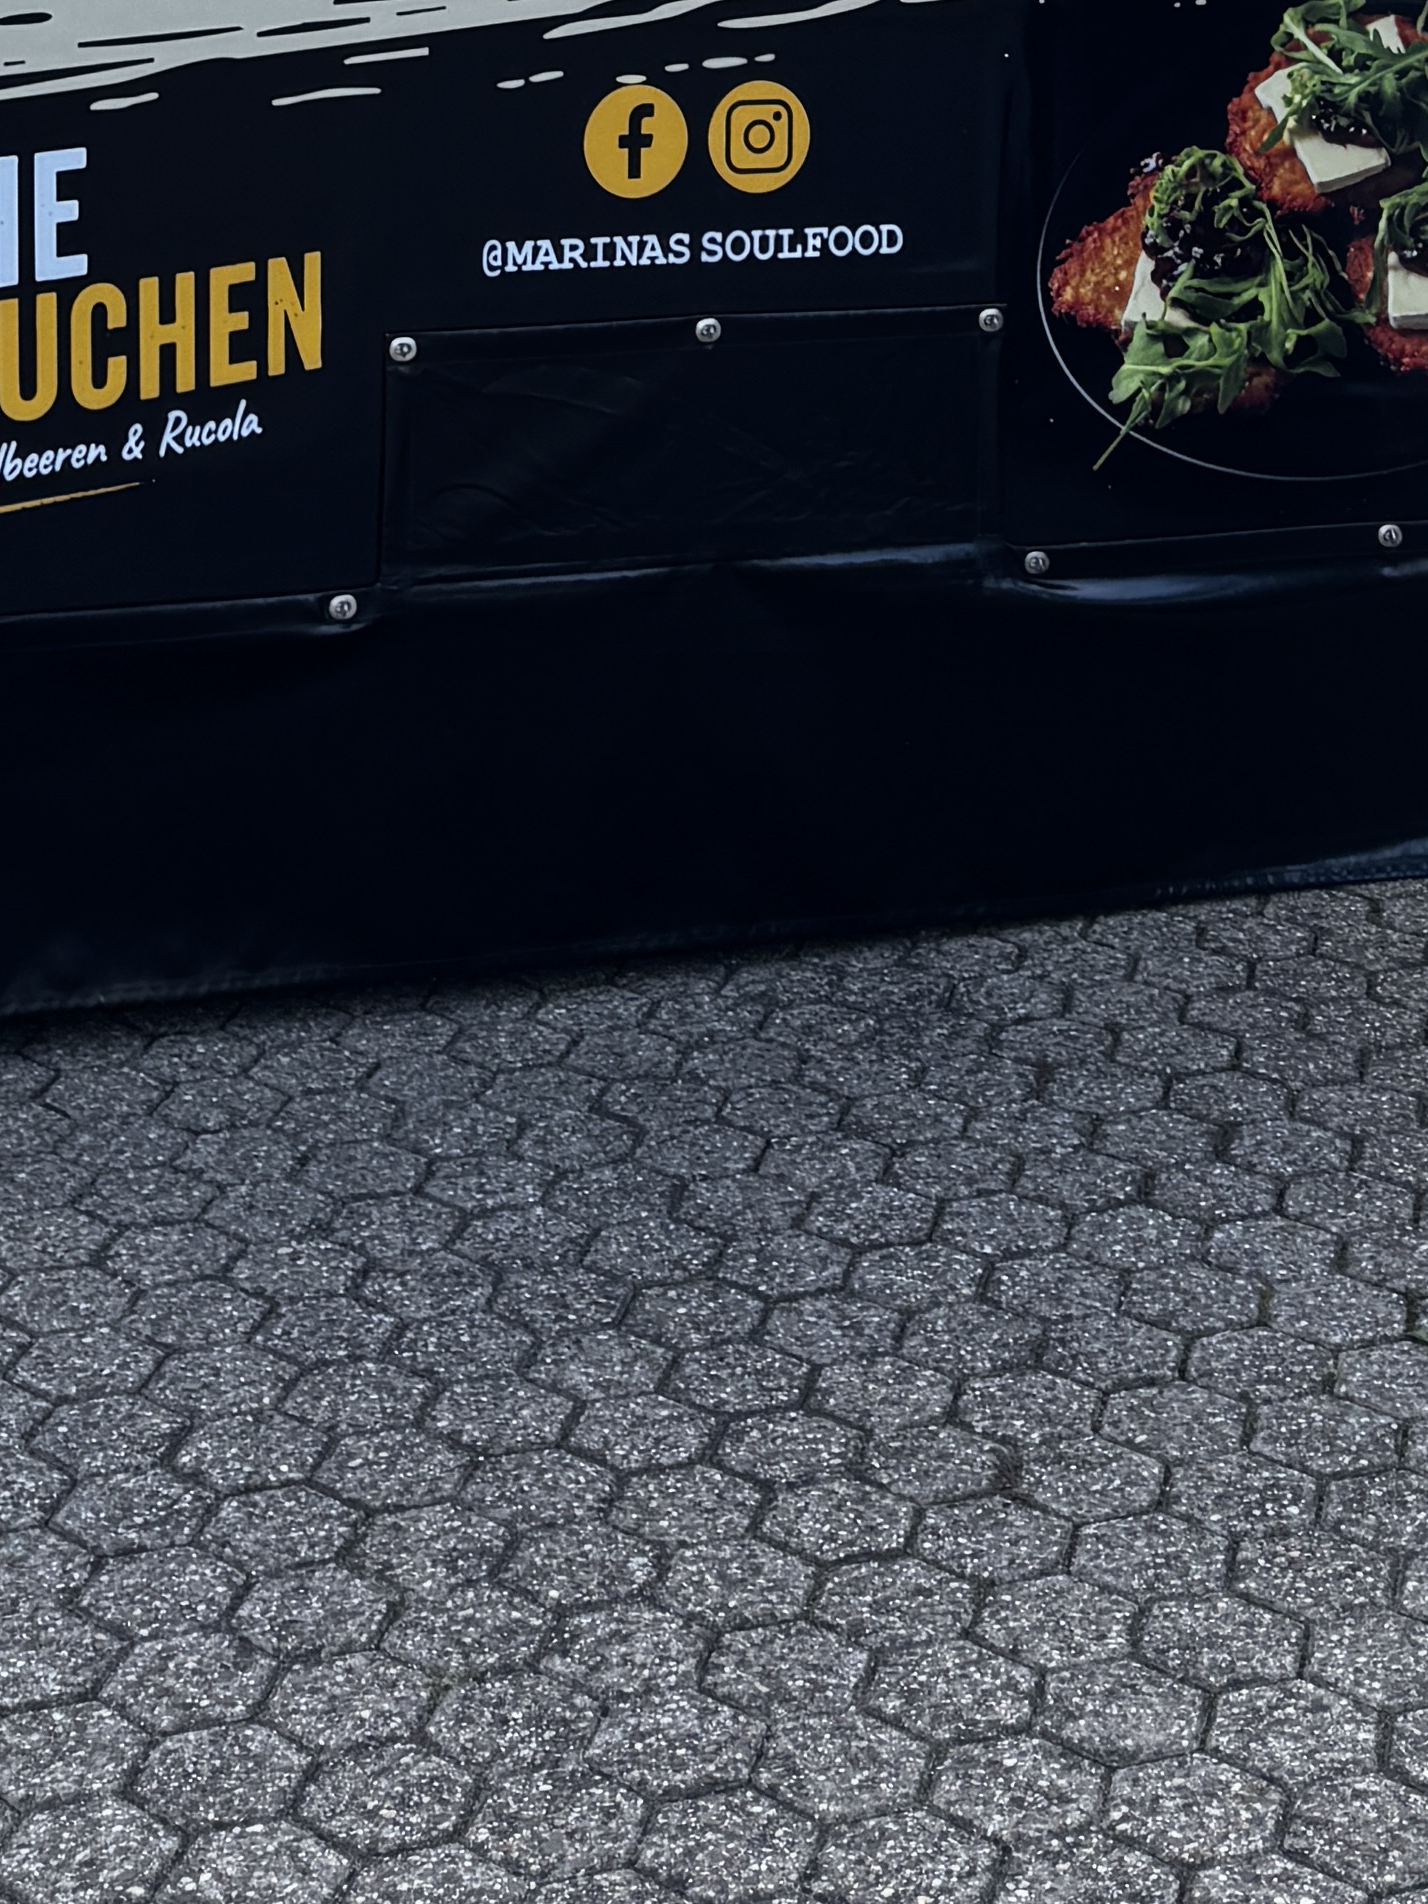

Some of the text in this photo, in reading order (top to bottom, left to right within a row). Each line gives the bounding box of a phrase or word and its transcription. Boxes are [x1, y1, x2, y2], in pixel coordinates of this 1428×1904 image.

[481, 223, 904, 277] @MARINAS SOULFOOD
[121, 422, 145, 461] &
[158, 398, 263, 460] Rucola
